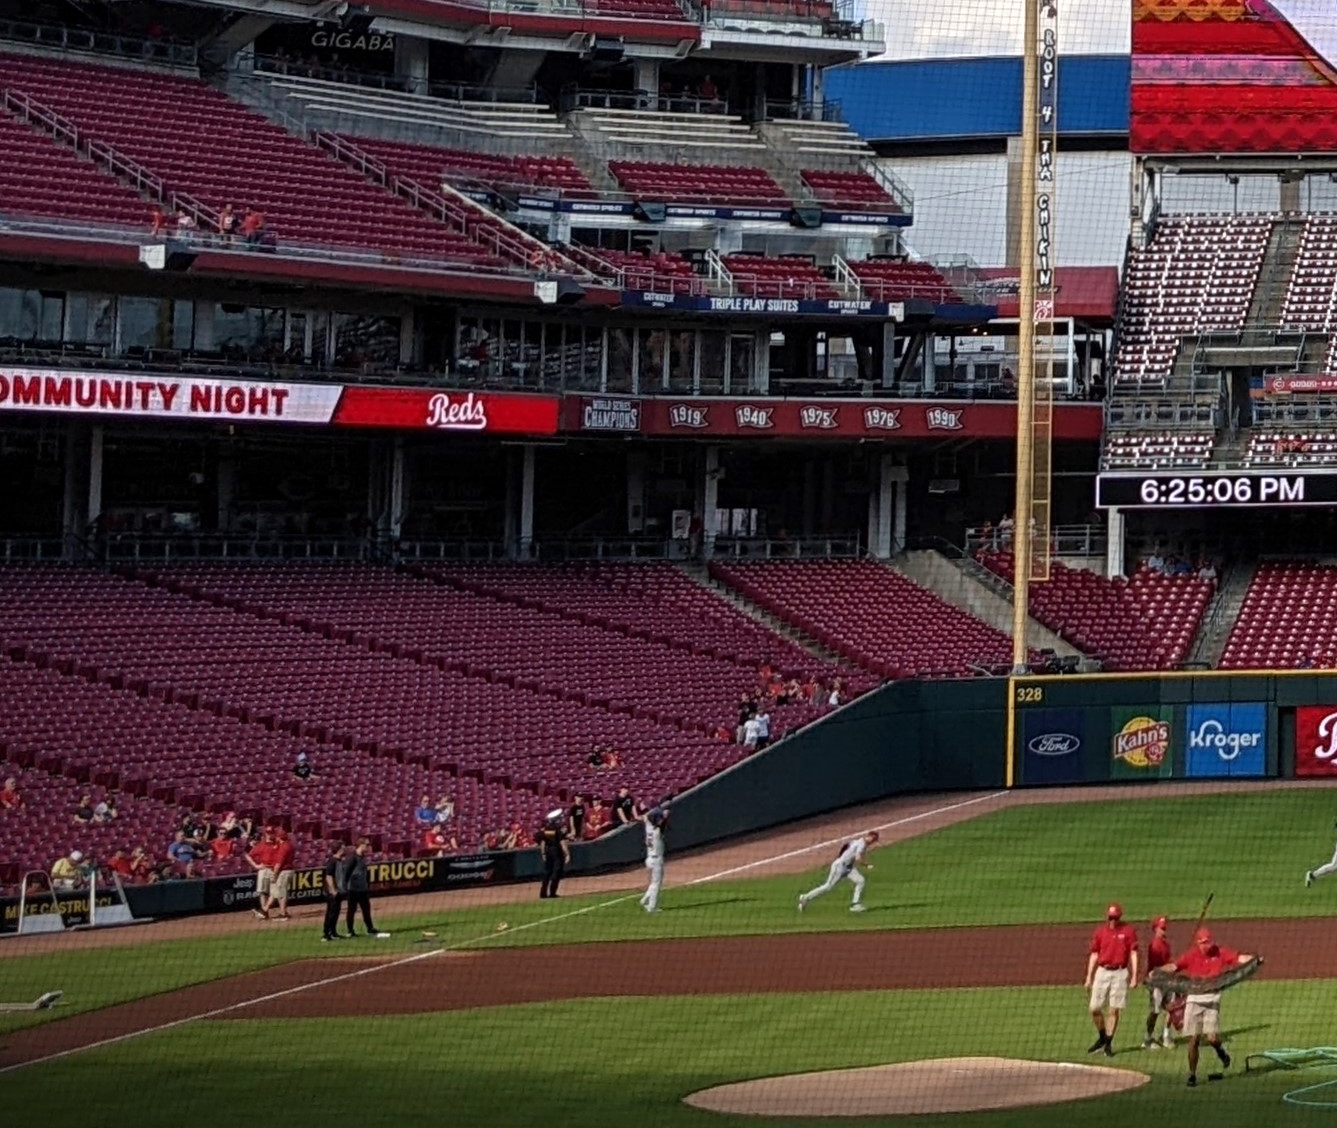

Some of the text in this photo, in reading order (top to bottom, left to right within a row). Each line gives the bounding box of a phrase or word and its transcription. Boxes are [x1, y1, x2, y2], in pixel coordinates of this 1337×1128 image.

[710, 297, 799, 312] TRIPLE PLAY SUITES
[0, 374, 288, 417] MMUNITY NIGHT
[426, 391, 487, 430] Reds
[584, 407, 638, 429] CHAMPIONS
[671, 407, 701, 426] 1919
[737, 407, 767, 425] 1940
[802, 406, 831, 426] 1975
[866, 408, 894, 427] 1976
[927, 409, 956, 428] 1990
[1140, 476, 1305, 503] 6:25:06 PM
[1016, 687, 1043, 702] 328
[1038, 735, 1071, 752] Ford
[1117, 724, 1169, 753] Kahn's
[1190, 719, 1261, 760] Kroger
[233, 877, 255, 889] Jeep
